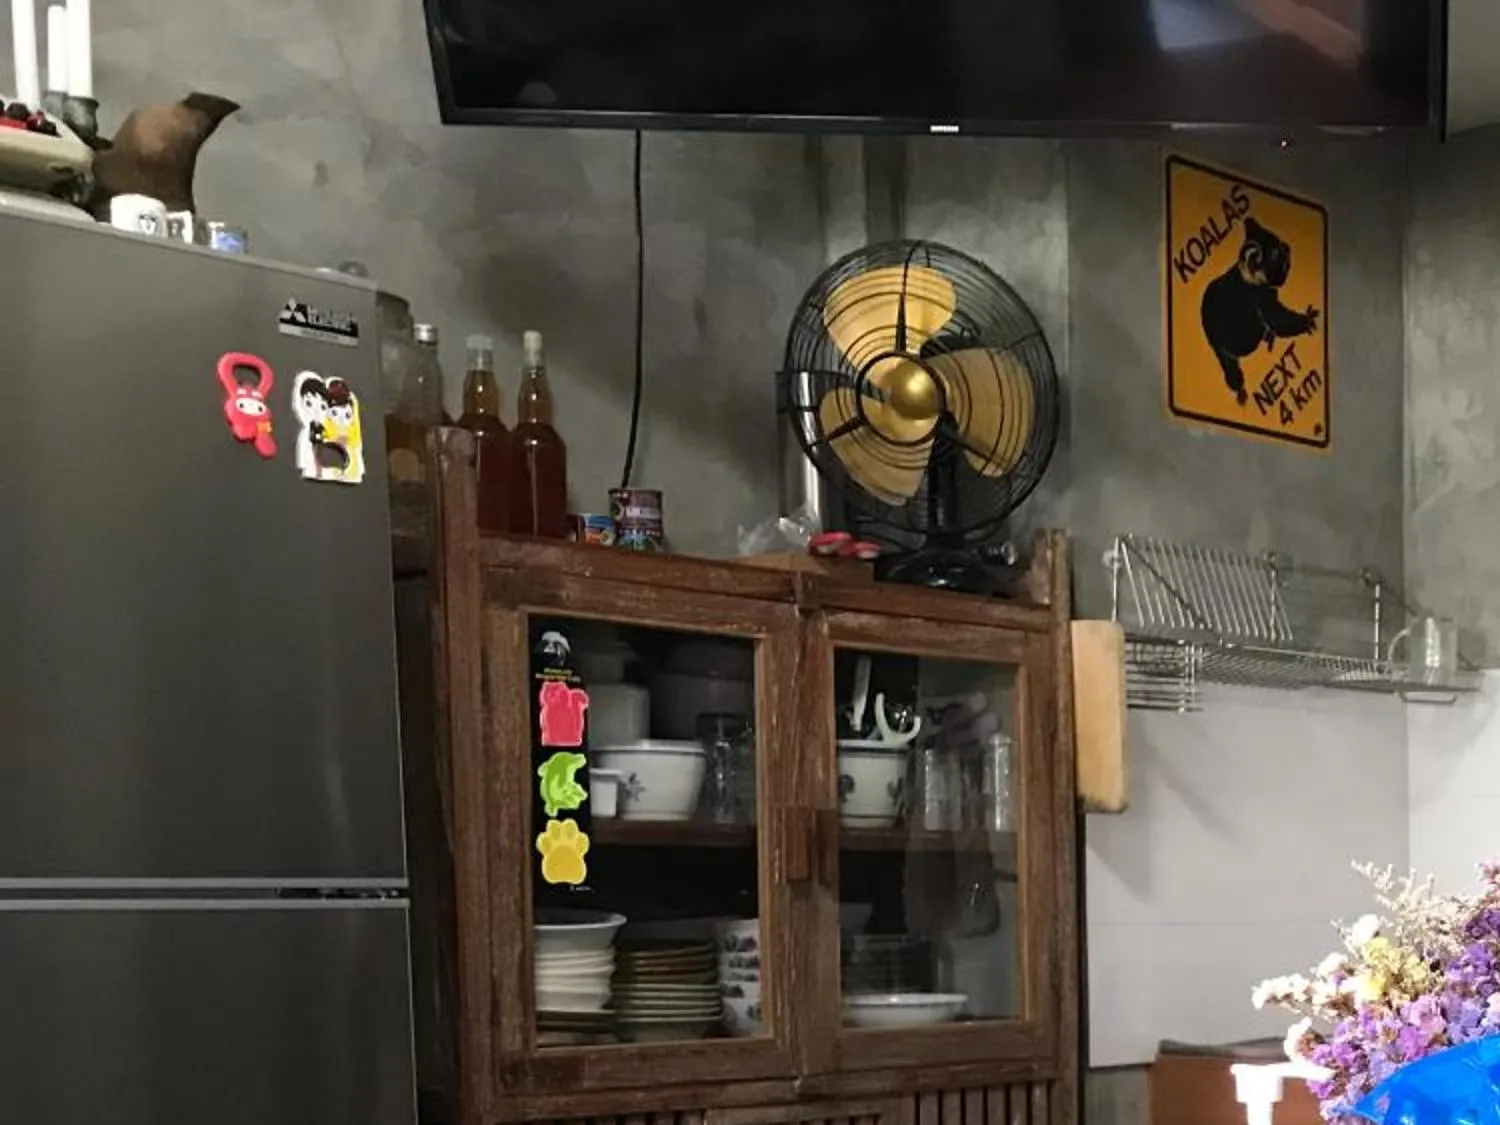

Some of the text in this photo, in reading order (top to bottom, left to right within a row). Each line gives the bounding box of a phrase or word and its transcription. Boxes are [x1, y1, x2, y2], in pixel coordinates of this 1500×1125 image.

[1173, 183, 1252, 284] KOALAS
[1252, 341, 1303, 416] NEXT
[1278, 367, 1323, 427] 4 km
